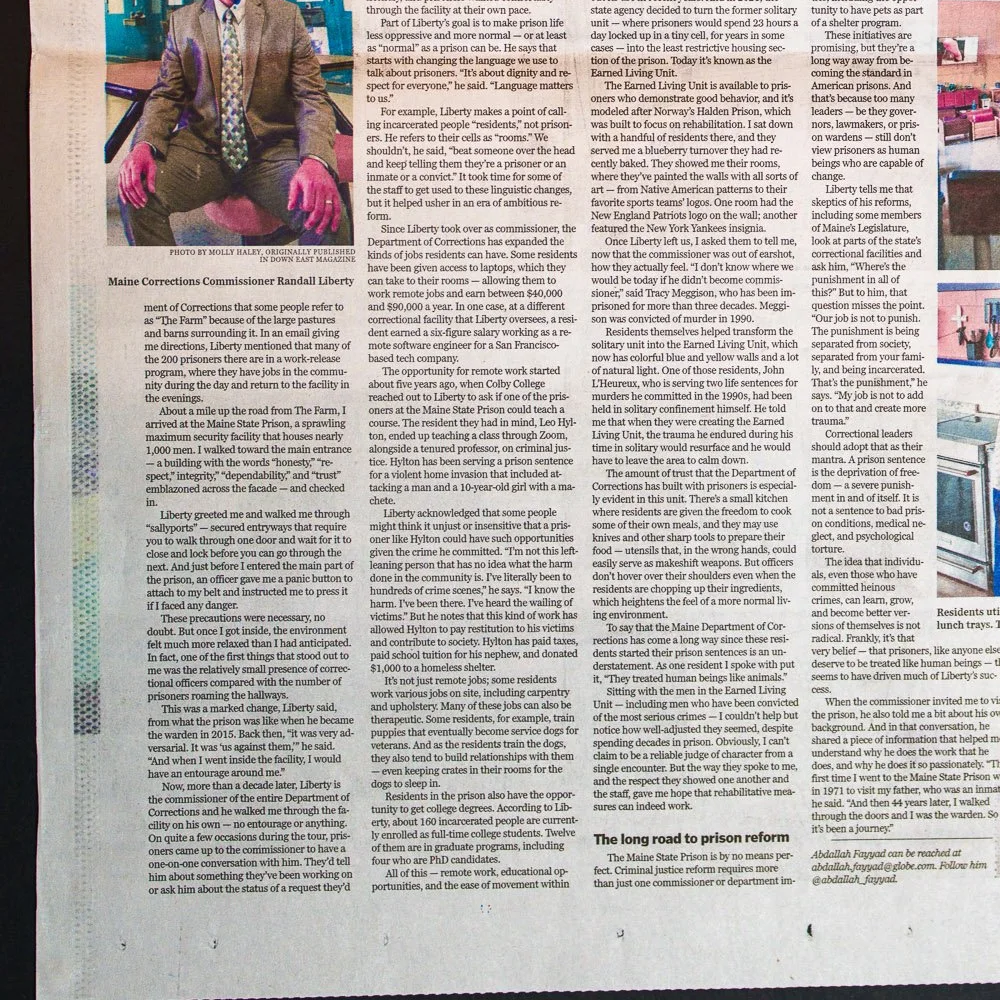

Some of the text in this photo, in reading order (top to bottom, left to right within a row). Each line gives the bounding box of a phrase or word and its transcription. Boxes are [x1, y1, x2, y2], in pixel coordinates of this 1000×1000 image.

[313, 248, 356, 257] PUBLISHED
[108, 276, 354, 287] Maine Corrections Commissioner Randall Liberty
[936, 607, 984, 617] Residents
[370, 663, 401, 674] $1,000
[402, 664, 412, 672] to
[420, 662, 462, 672] homeless
[463, 662, 496, 672] shelter.
[147, 690, 288, 703] prisoners roaming the hallways.
[593, 831, 789, 847] The long road to prison reform
[812, 874, 898, 886] @abdallah_fayyad.
